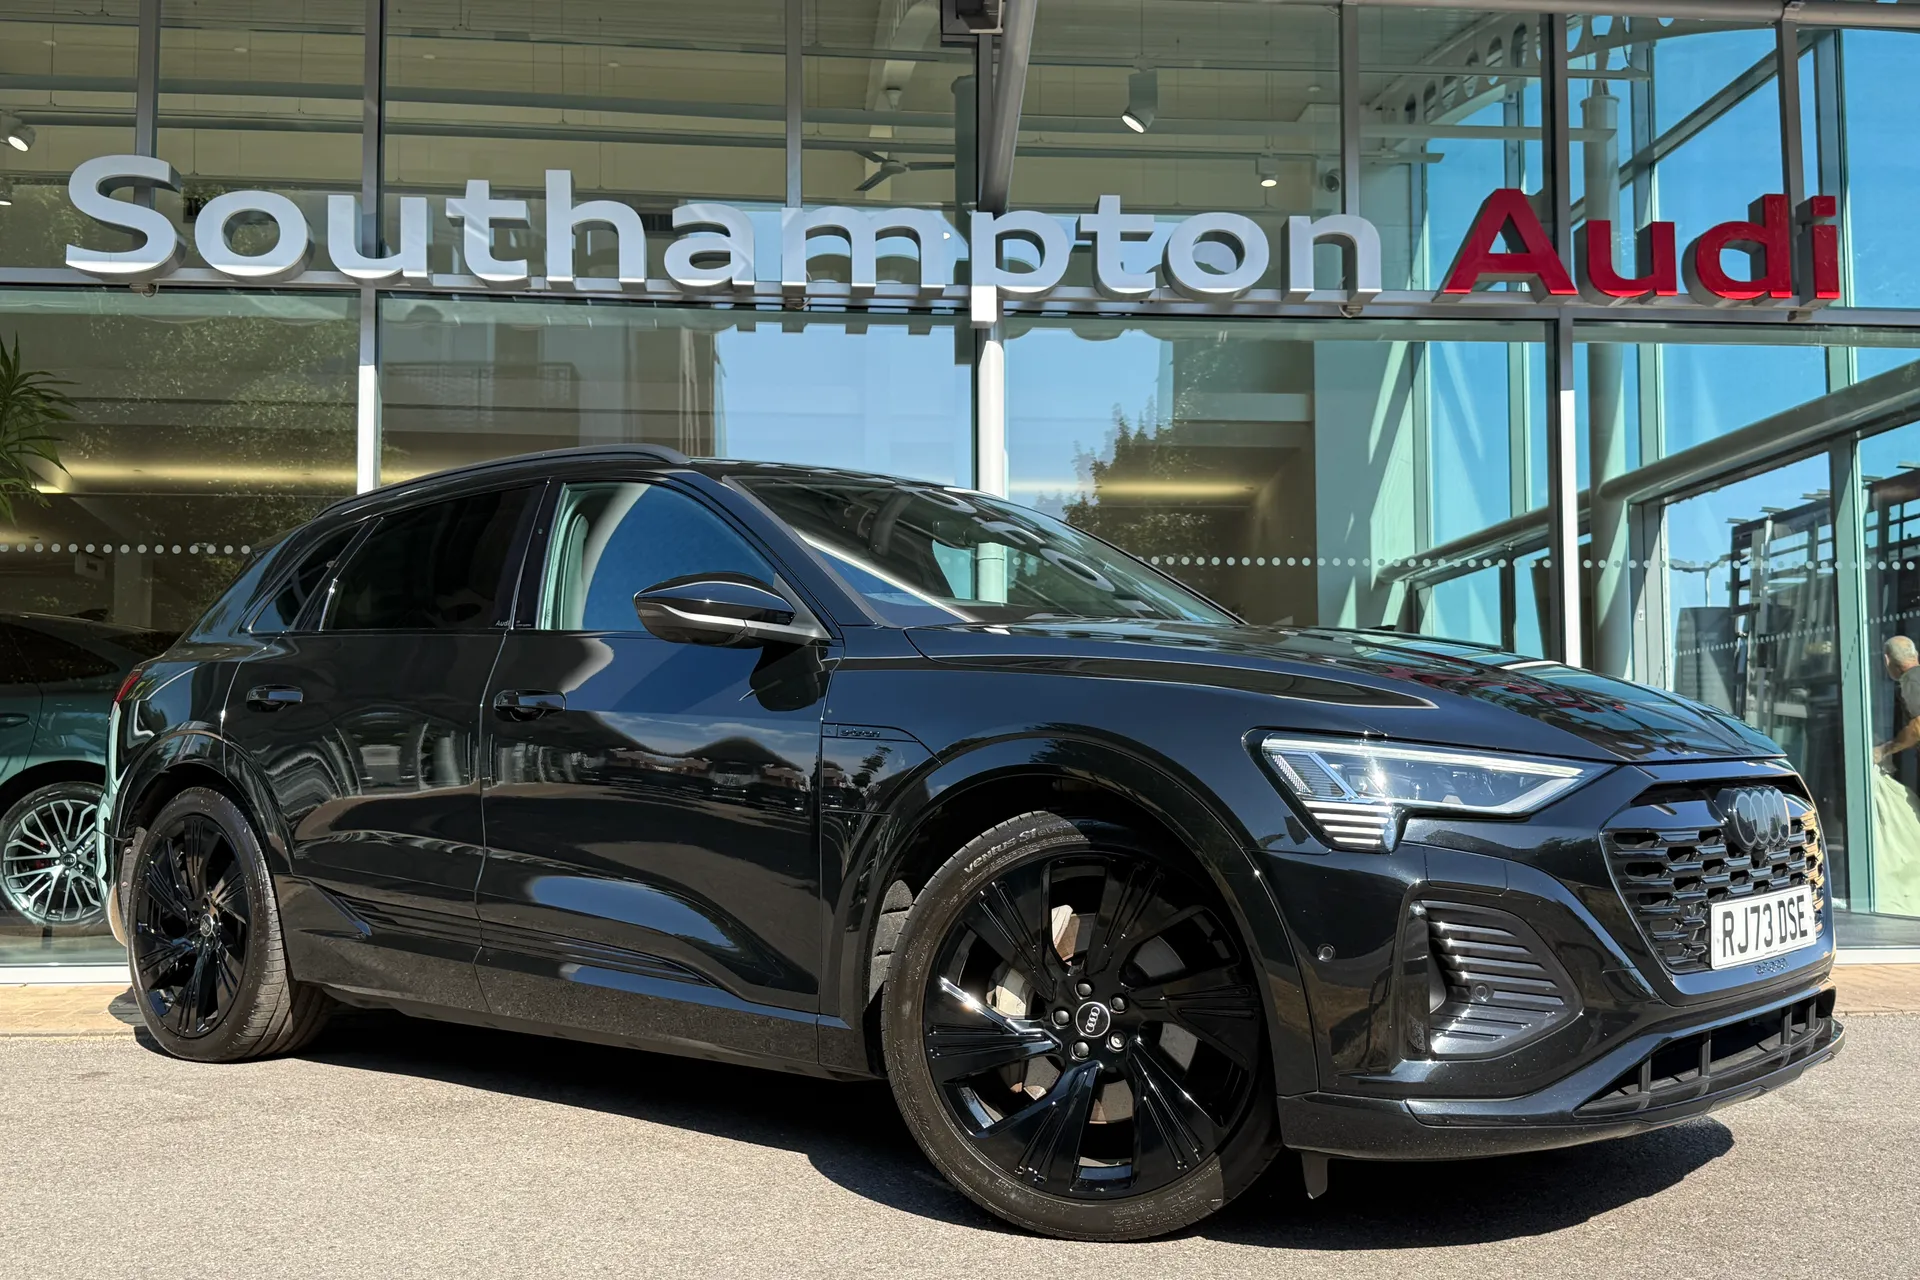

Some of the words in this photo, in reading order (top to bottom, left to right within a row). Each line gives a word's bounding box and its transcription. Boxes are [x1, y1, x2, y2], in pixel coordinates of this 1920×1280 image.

[65, 154, 1383, 323] Southampton
[1436, 187, 1841, 301] Audi
[1722, 903, 1774, 958] RJ73
[1777, 895, 1808, 944] DSE
